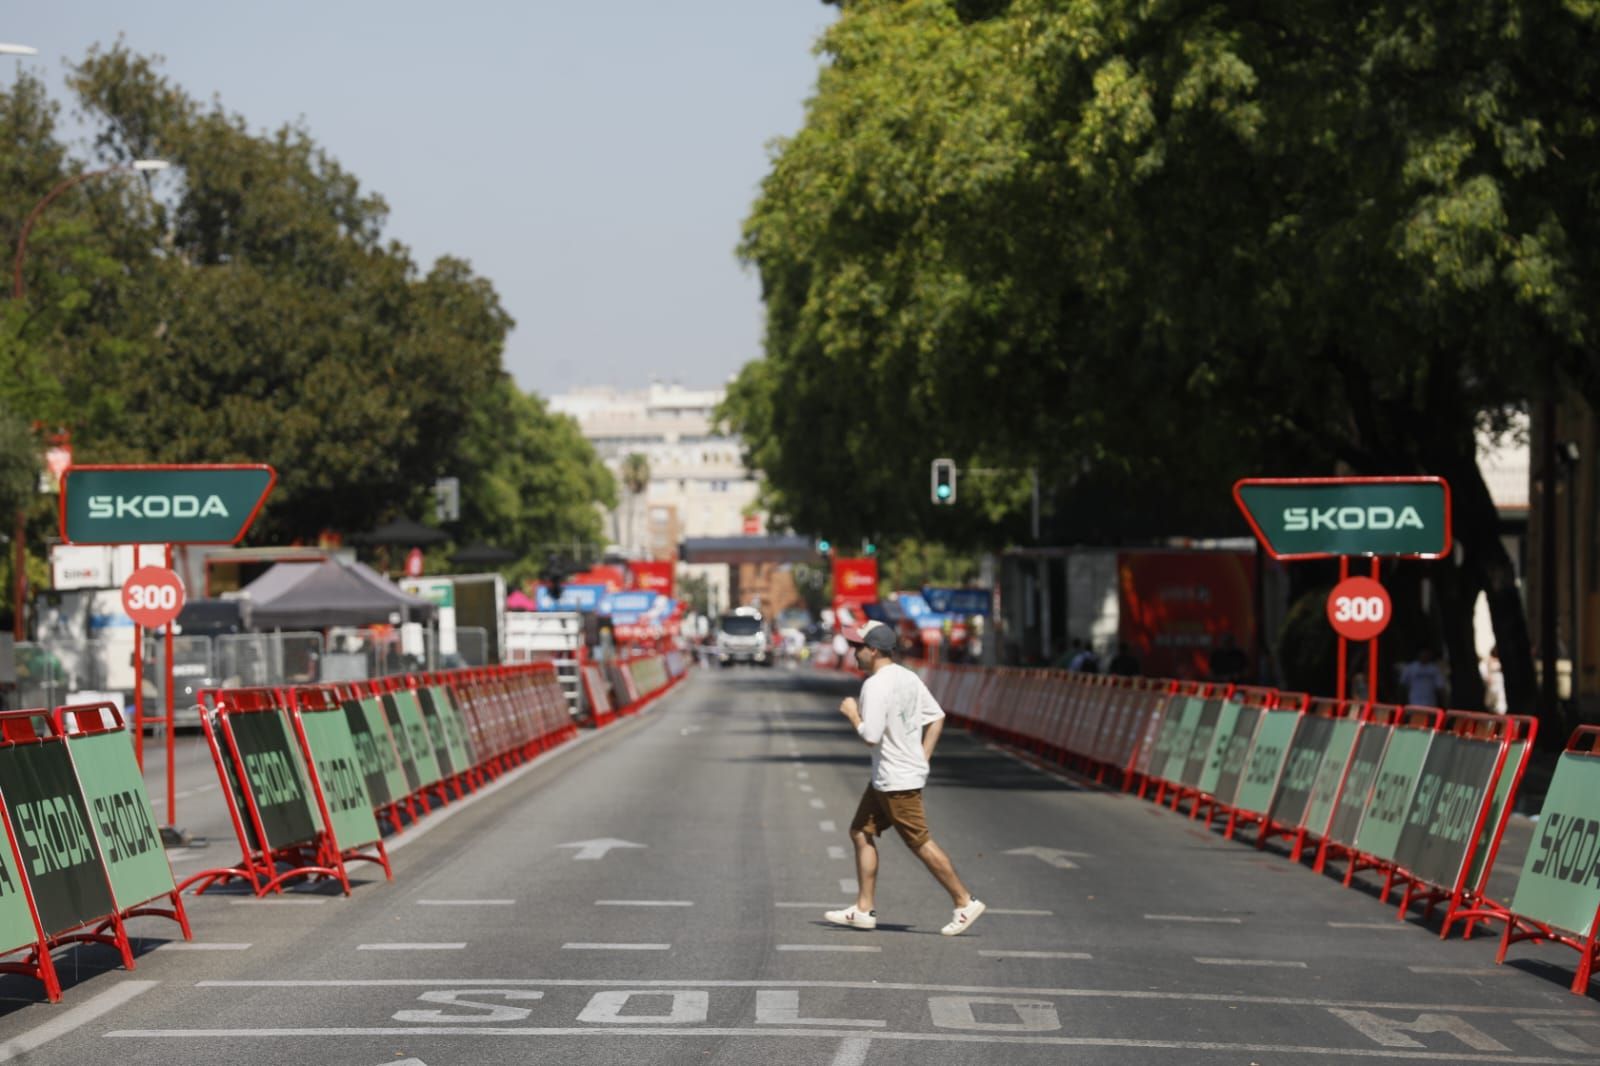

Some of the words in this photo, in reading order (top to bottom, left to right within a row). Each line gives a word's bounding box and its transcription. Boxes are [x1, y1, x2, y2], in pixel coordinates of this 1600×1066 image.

[88, 495, 229, 518] SKODA
[1283, 506, 1424, 531] SKODA
[128, 584, 176, 610] 300
[1335, 596, 1384, 622] 300
[246, 750, 300, 807] SKODA
[16, 794, 95, 876] SKODA
[93, 788, 158, 864] SKODA
[392, 988, 1062, 1032] SOLO
